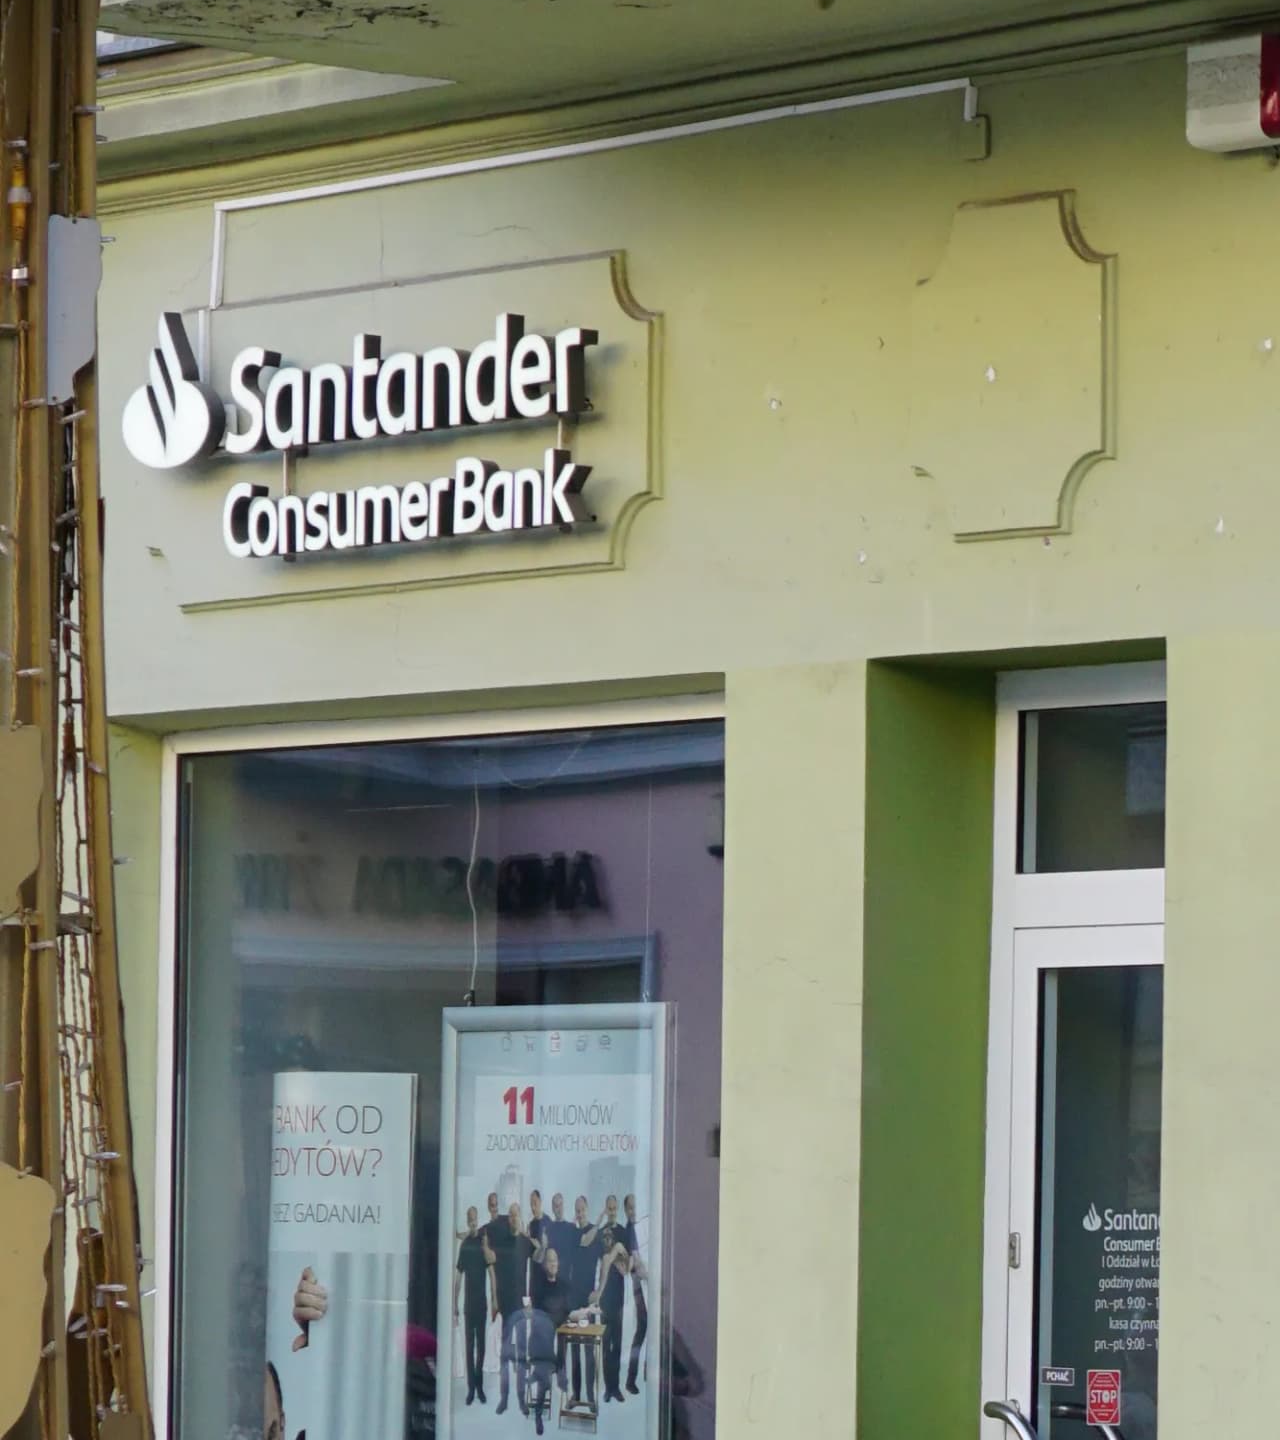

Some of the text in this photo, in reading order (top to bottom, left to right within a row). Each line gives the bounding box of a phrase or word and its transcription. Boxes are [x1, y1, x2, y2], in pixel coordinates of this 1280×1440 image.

[225, 312, 598, 454] Santander
[503, 1086, 614, 1126] 11 MILIONÓW
[336, 1104, 383, 1135] OD
[486, 1133, 580, 1152] ZADOWOLONYCH
[293, 1202, 381, 1225] GADANIA!
[1103, 1208, 1161, 1232] Santan
[1103, 1236, 1155, 1252] Consumer
[1106, 1254, 1140, 1268] Oddział
[1141, 1258, 1149, 1268] w
[1098, 1275, 1134, 1292] godziny
[1126, 1296, 1146, 1310] 9:00
[1108, 1316, 1129, 1330] kasa
[1126, 1337, 1146, 1351] 9:00
[1046, 1370, 1070, 1382] PCHAĆ
[1090, 1389, 1117, 1404] STOP
